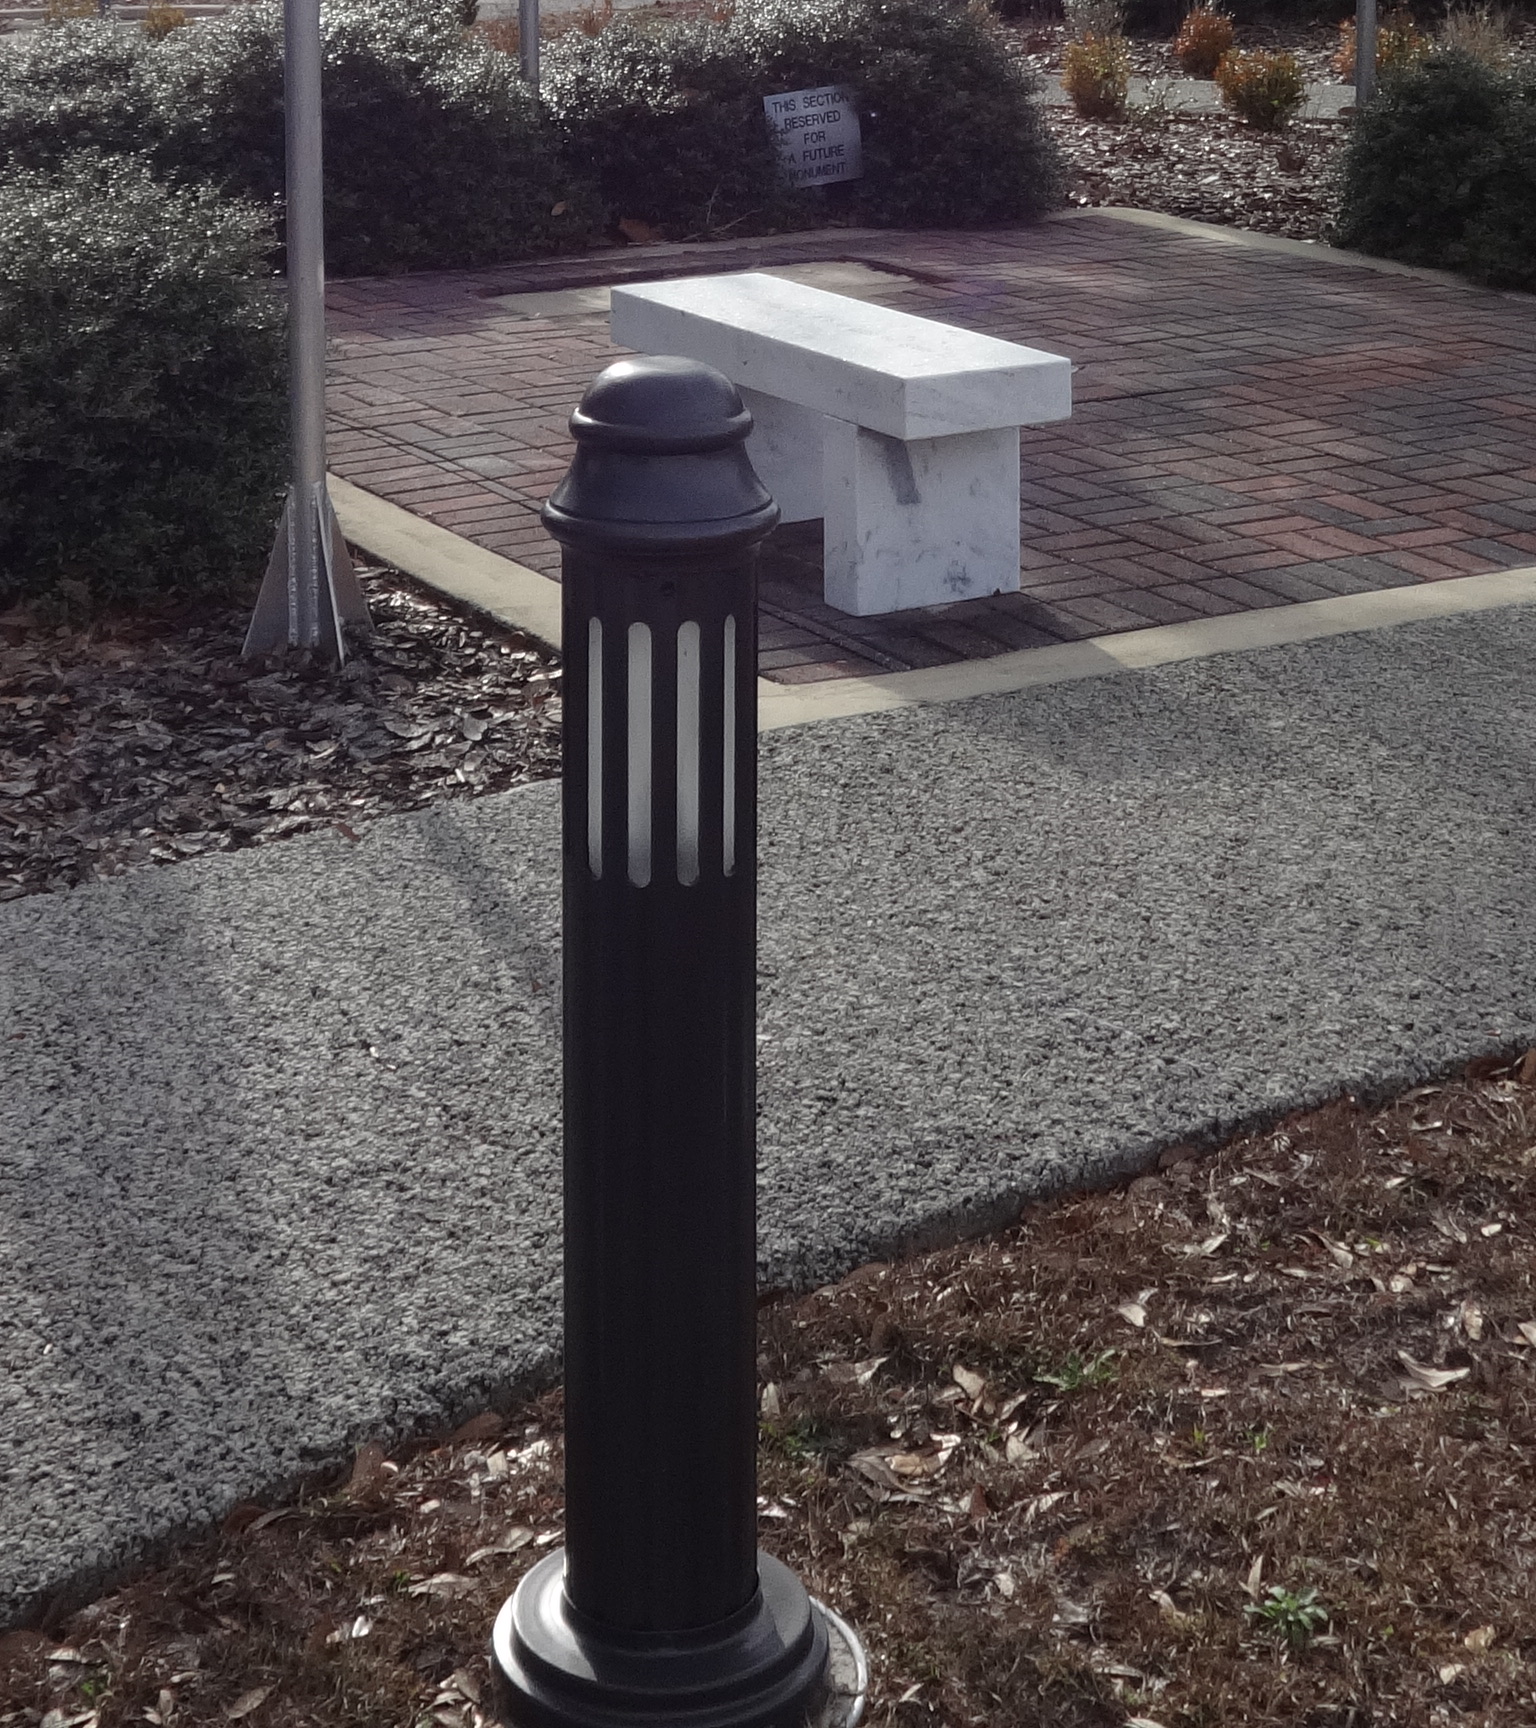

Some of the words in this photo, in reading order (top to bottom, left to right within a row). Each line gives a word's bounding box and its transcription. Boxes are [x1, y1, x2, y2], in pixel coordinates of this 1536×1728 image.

[772, 99, 796, 113] THIS
[784, 110, 841, 130] RESERVED
[804, 131, 826, 144] FOR
[788, 153, 796, 164] A
[803, 144, 845, 162] FUTURE
